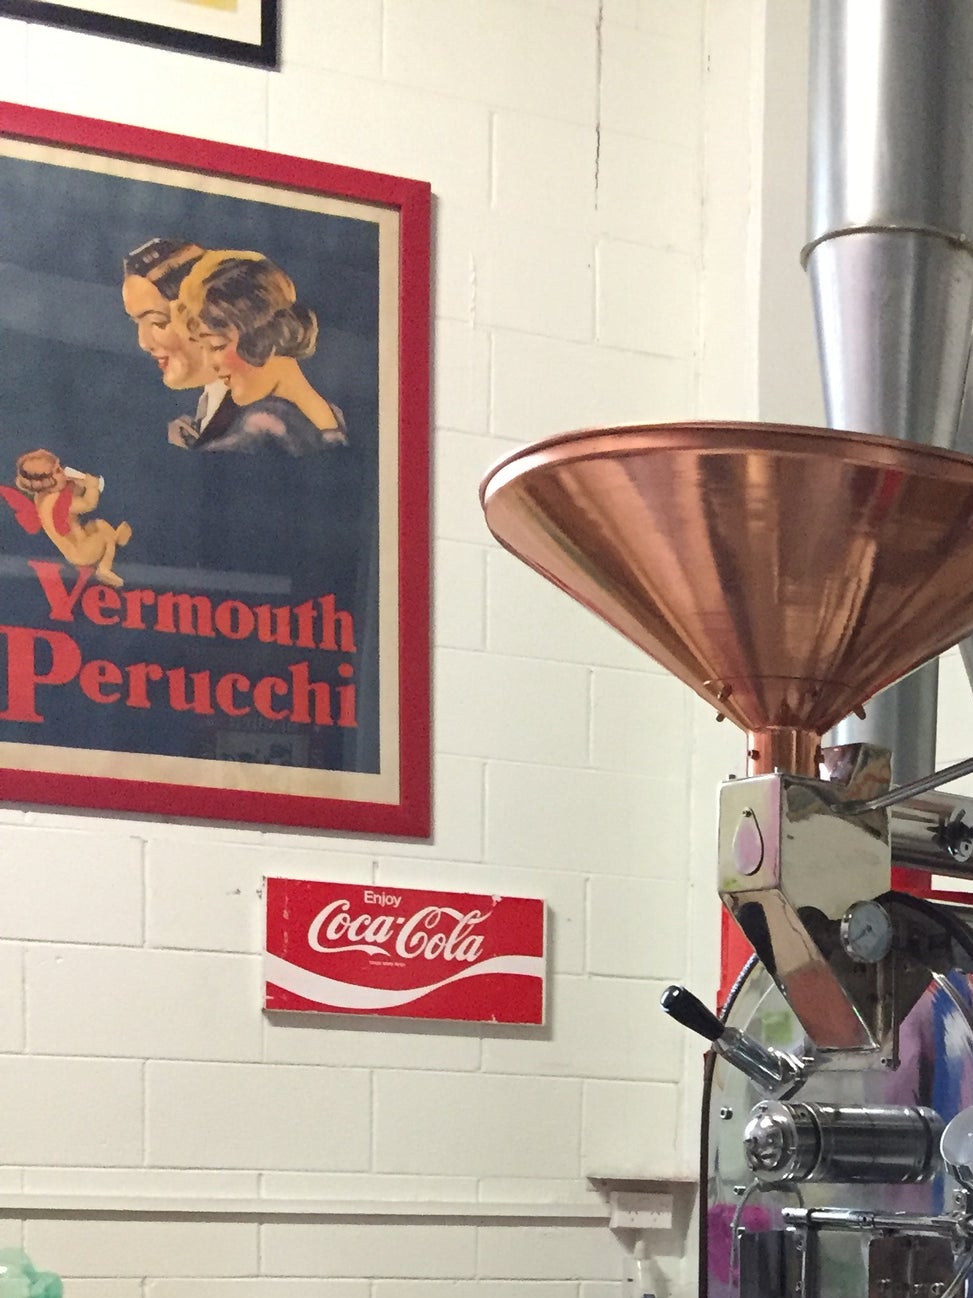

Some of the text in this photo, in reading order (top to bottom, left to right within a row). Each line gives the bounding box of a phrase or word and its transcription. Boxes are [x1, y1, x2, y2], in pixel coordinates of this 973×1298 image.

[27, 560, 357, 653] Vermouth
[0, 625, 358, 728] Perucchi
[307, 899, 491, 962] Coca-Cola
[363, 890, 402, 908] Enjoy
